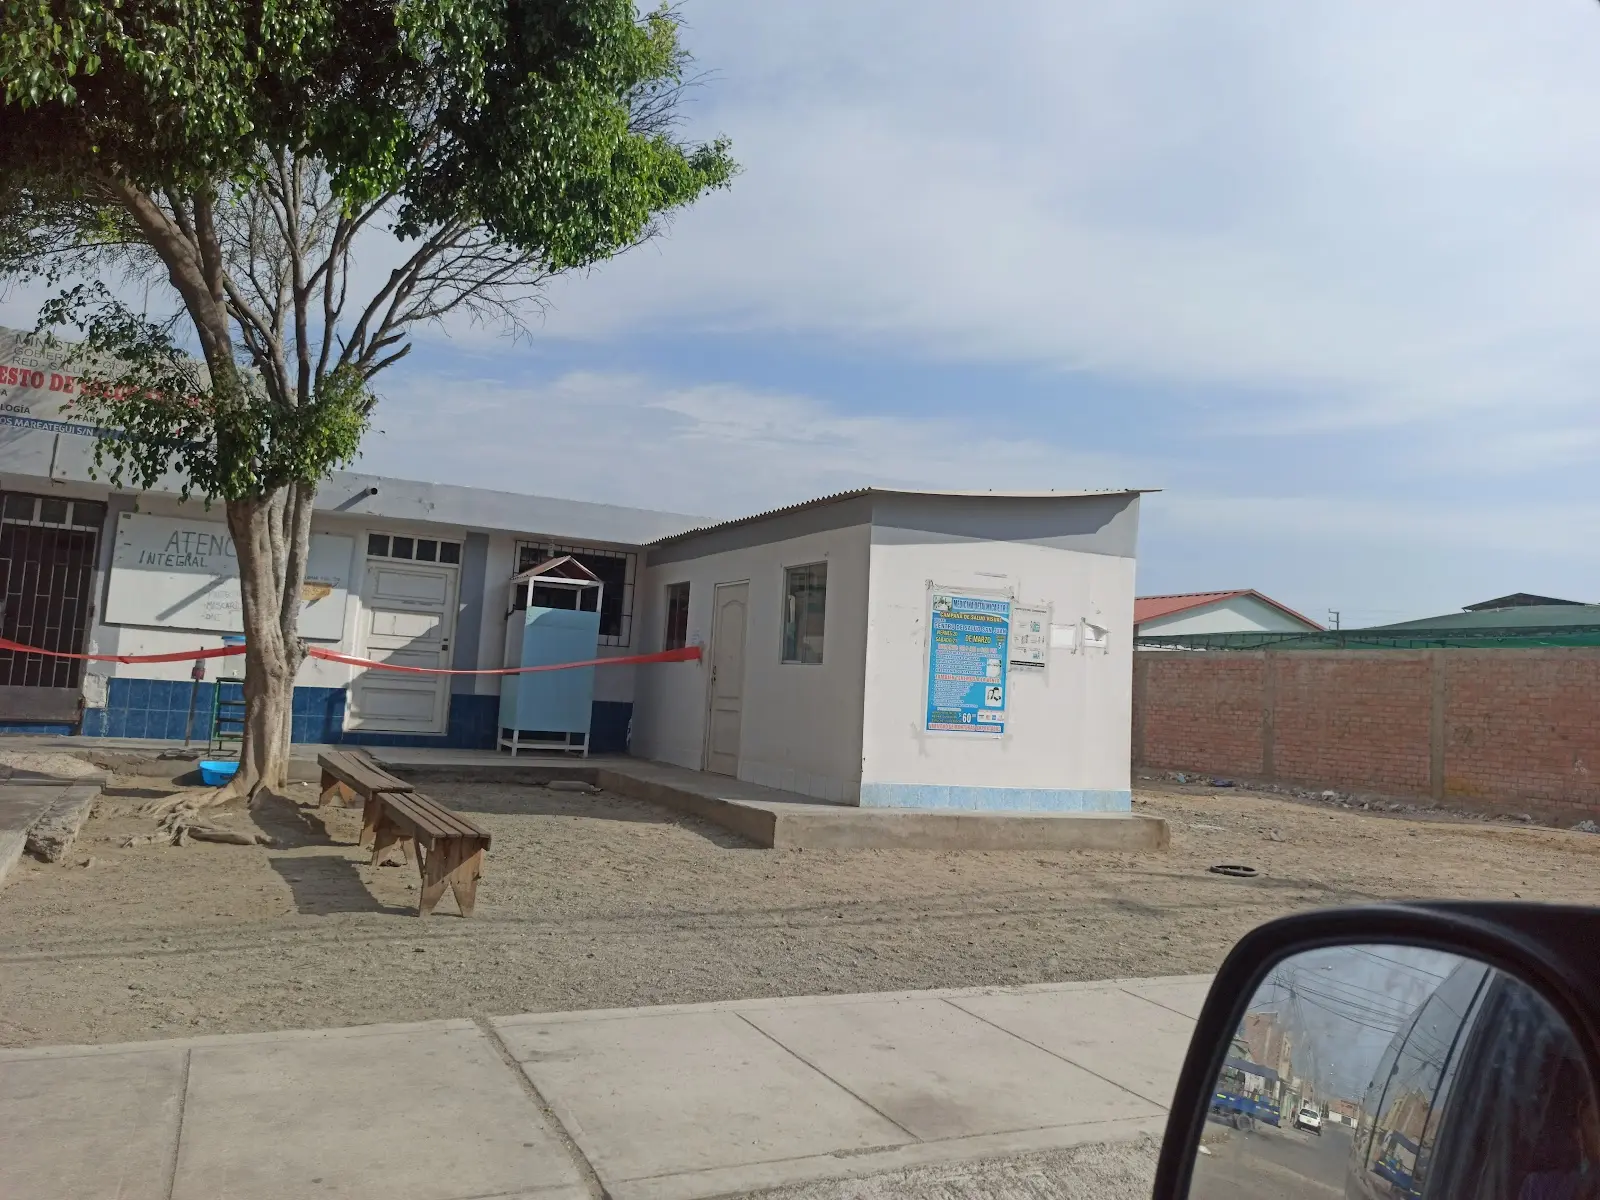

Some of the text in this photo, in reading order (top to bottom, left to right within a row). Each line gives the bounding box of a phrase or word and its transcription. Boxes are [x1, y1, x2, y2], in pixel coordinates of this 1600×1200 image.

[13, 356, 38, 367] RED
[0, 366, 44, 389] ESTO
[49, 373, 75, 393] DE
[77, 427, 94, 436] S/N
[973, 635, 992, 644] MARZO
[962, 712, 972, 723] 60
